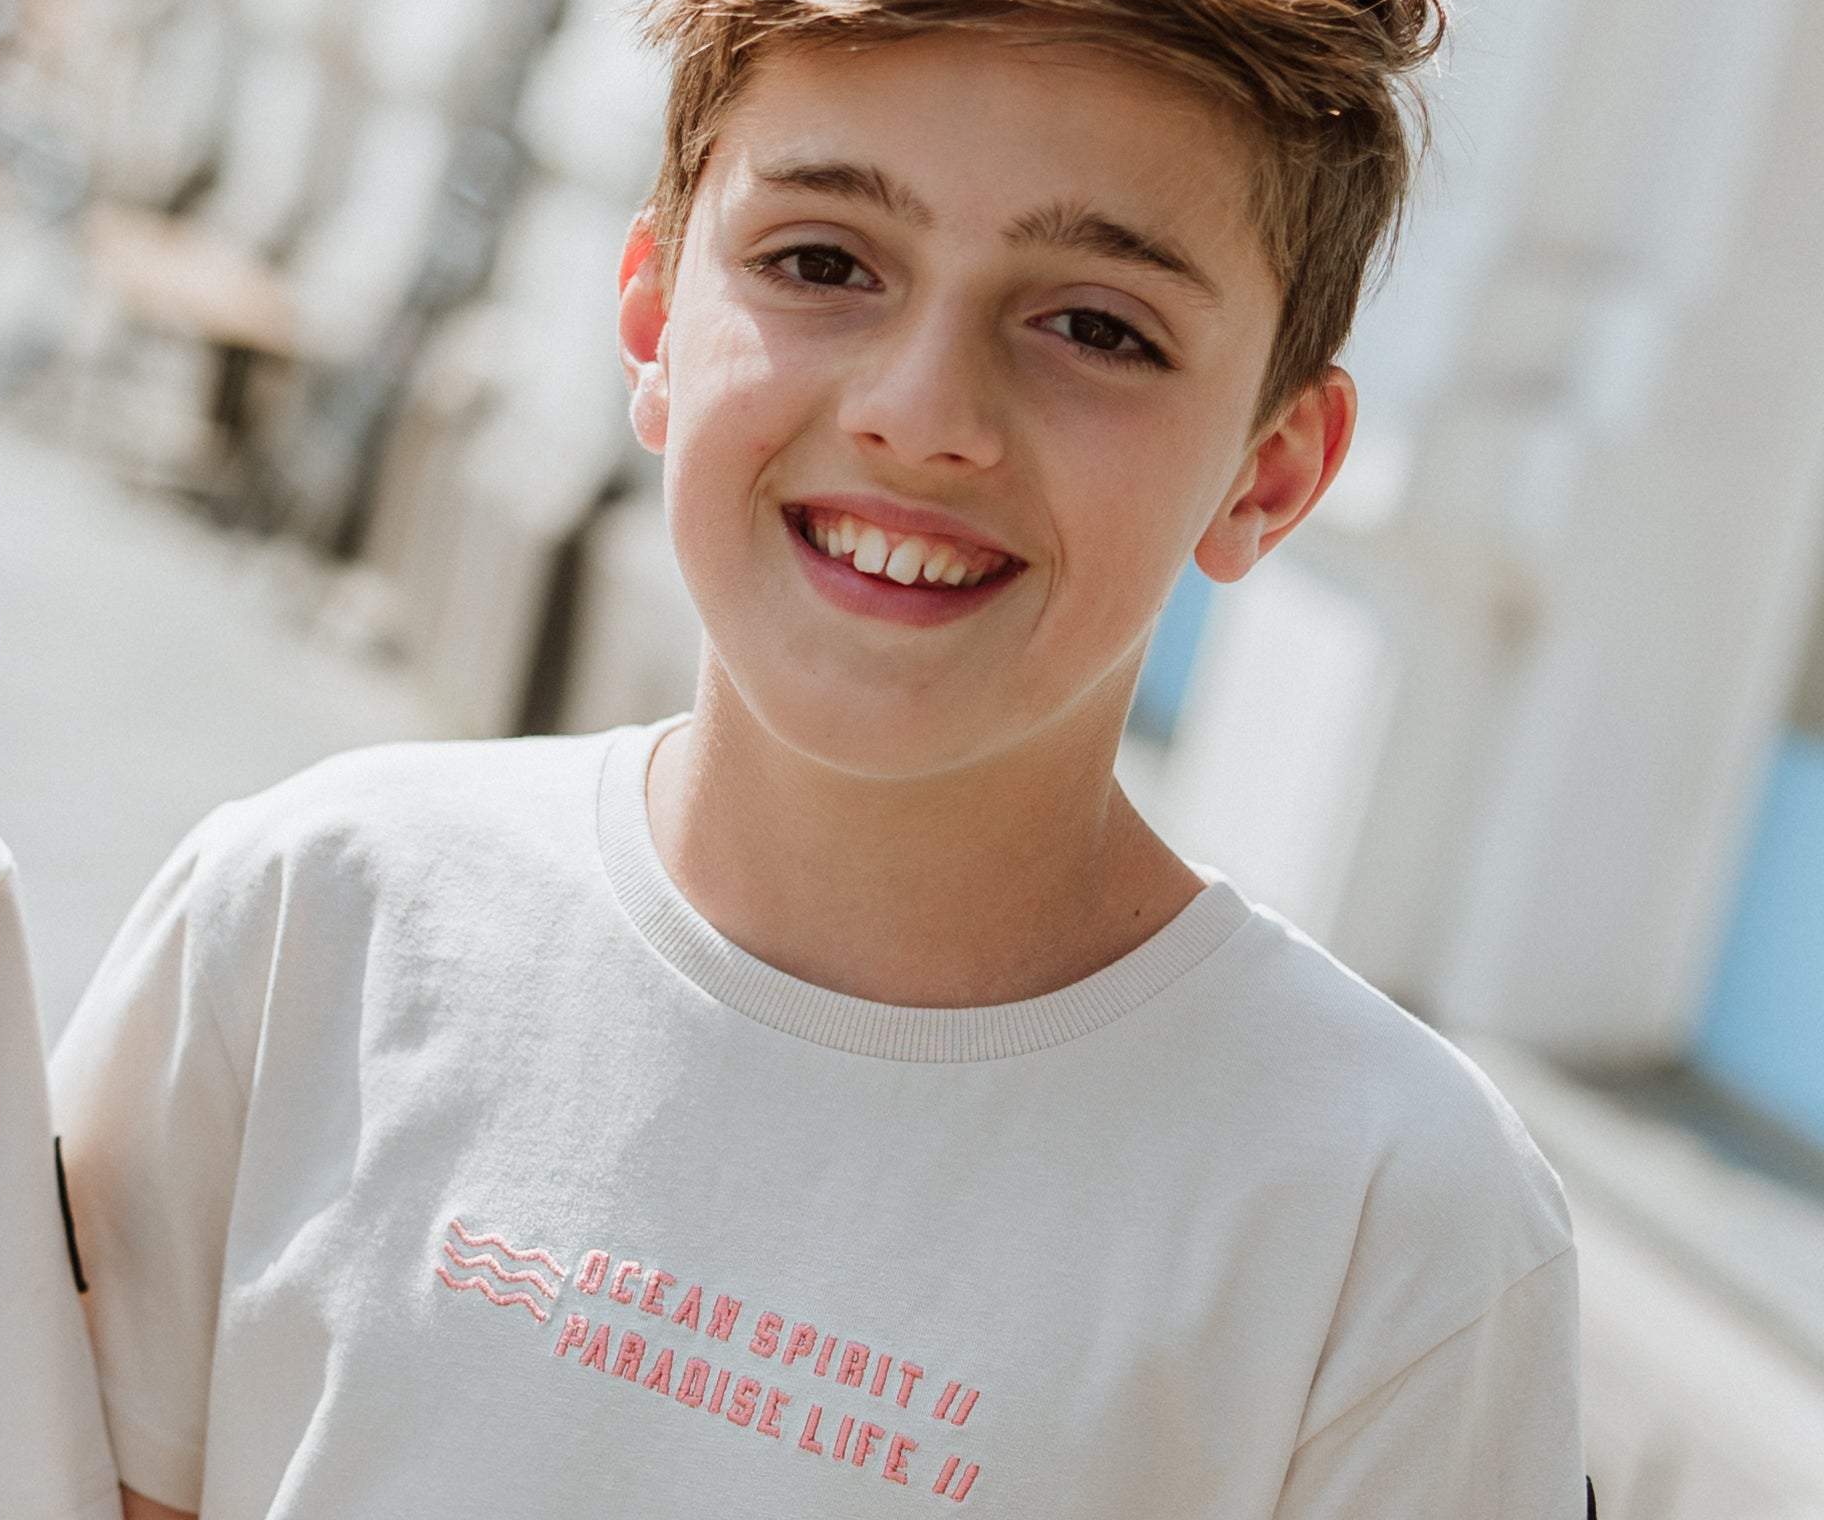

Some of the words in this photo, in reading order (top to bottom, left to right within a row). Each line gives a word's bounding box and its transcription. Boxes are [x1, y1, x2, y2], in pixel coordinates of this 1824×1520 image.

[553, 1312, 793, 1440] PARADISE
[798, 1404, 920, 1486] LIFE
[574, 1248, 743, 1342] OCEAN
[749, 1311, 924, 1409] SPIRIT
